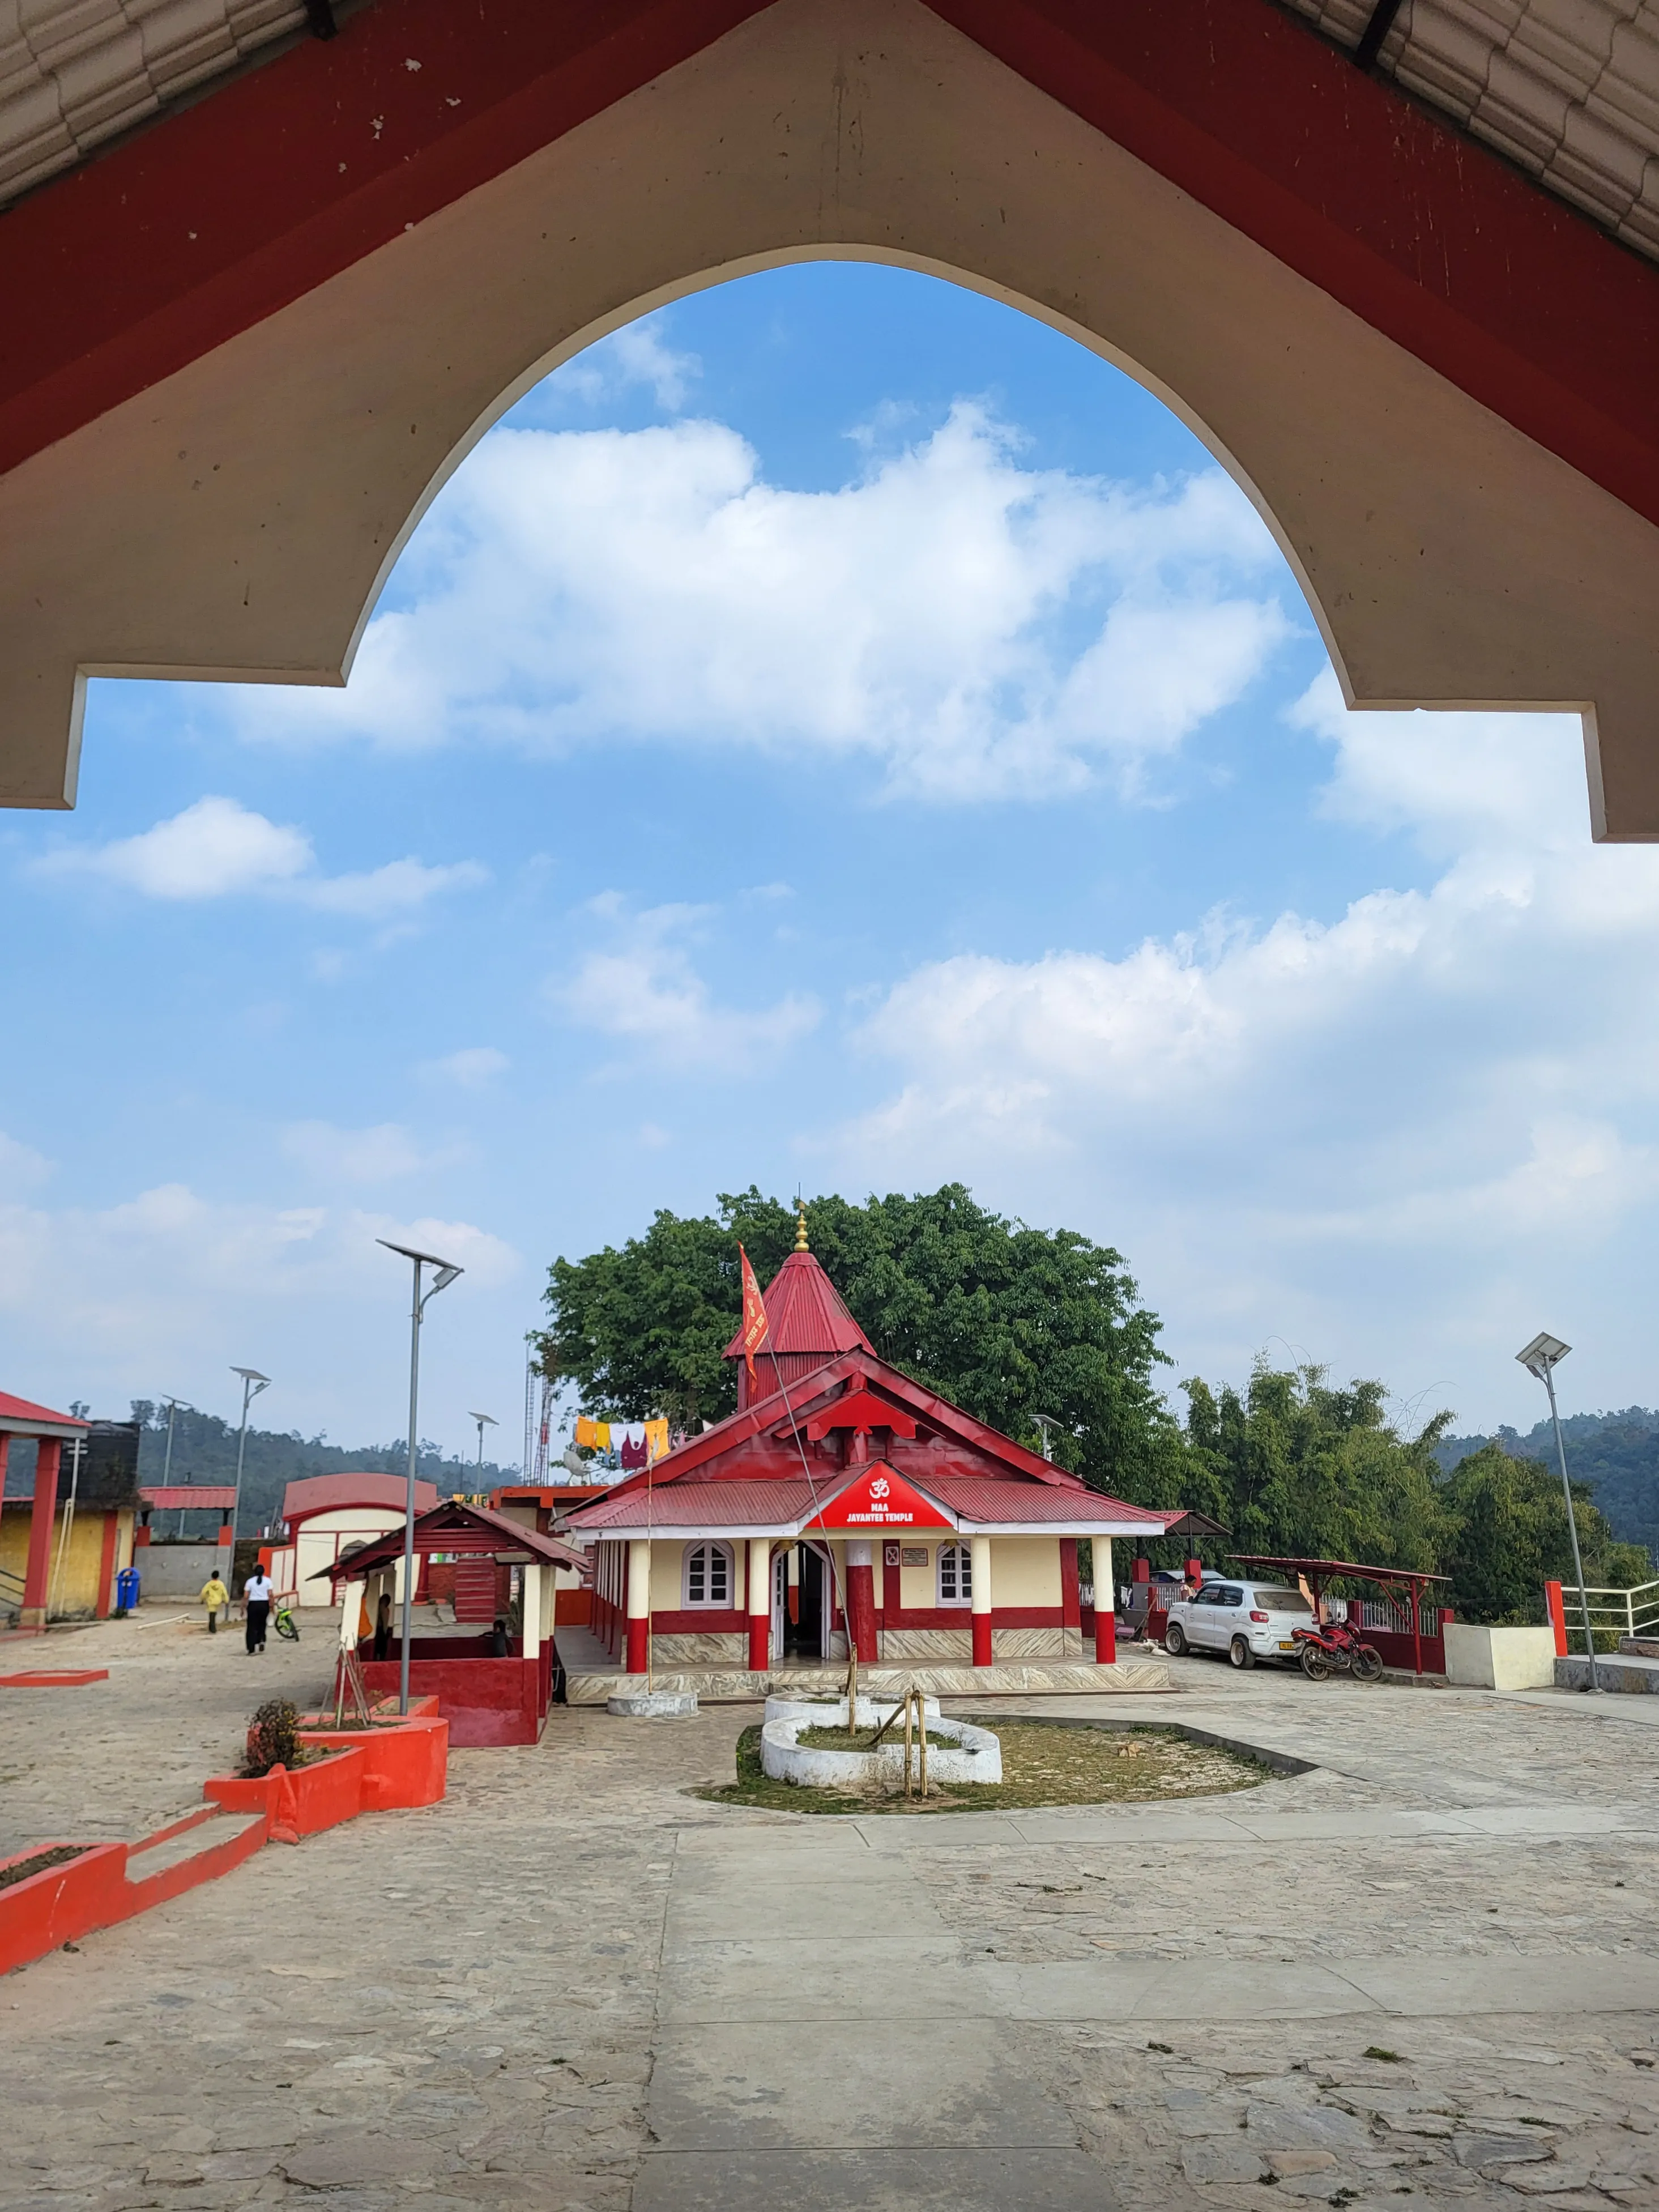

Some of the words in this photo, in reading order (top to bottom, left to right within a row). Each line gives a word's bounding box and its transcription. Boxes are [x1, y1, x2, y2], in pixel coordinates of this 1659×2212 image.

[871, 1503, 889, 1512] MAA
[847, 1513, 884, 1522] JAYANTEE
[885, 1513, 913, 1521] TEMPLE
